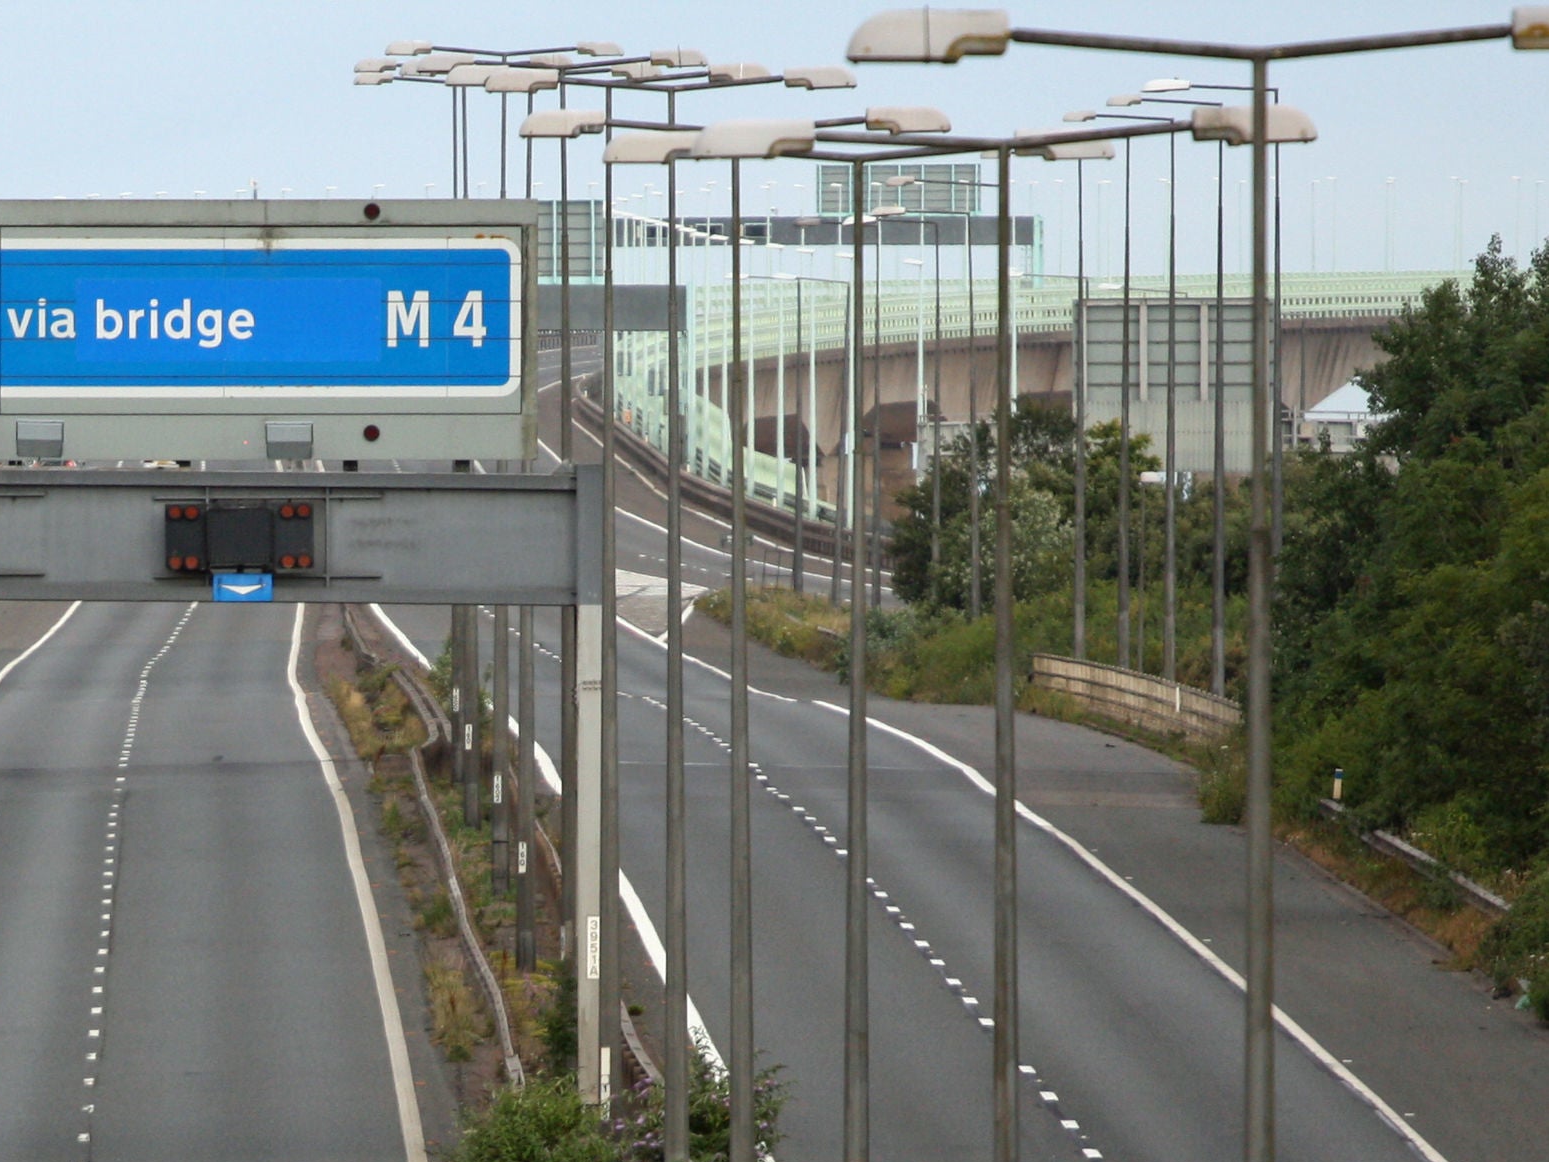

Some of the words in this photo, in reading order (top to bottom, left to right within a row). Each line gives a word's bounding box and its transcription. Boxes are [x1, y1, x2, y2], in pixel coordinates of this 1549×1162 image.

[8, 299, 75, 339] via
[97, 298, 255, 348] bridge
[590, 919, 598, 976] 3951A
